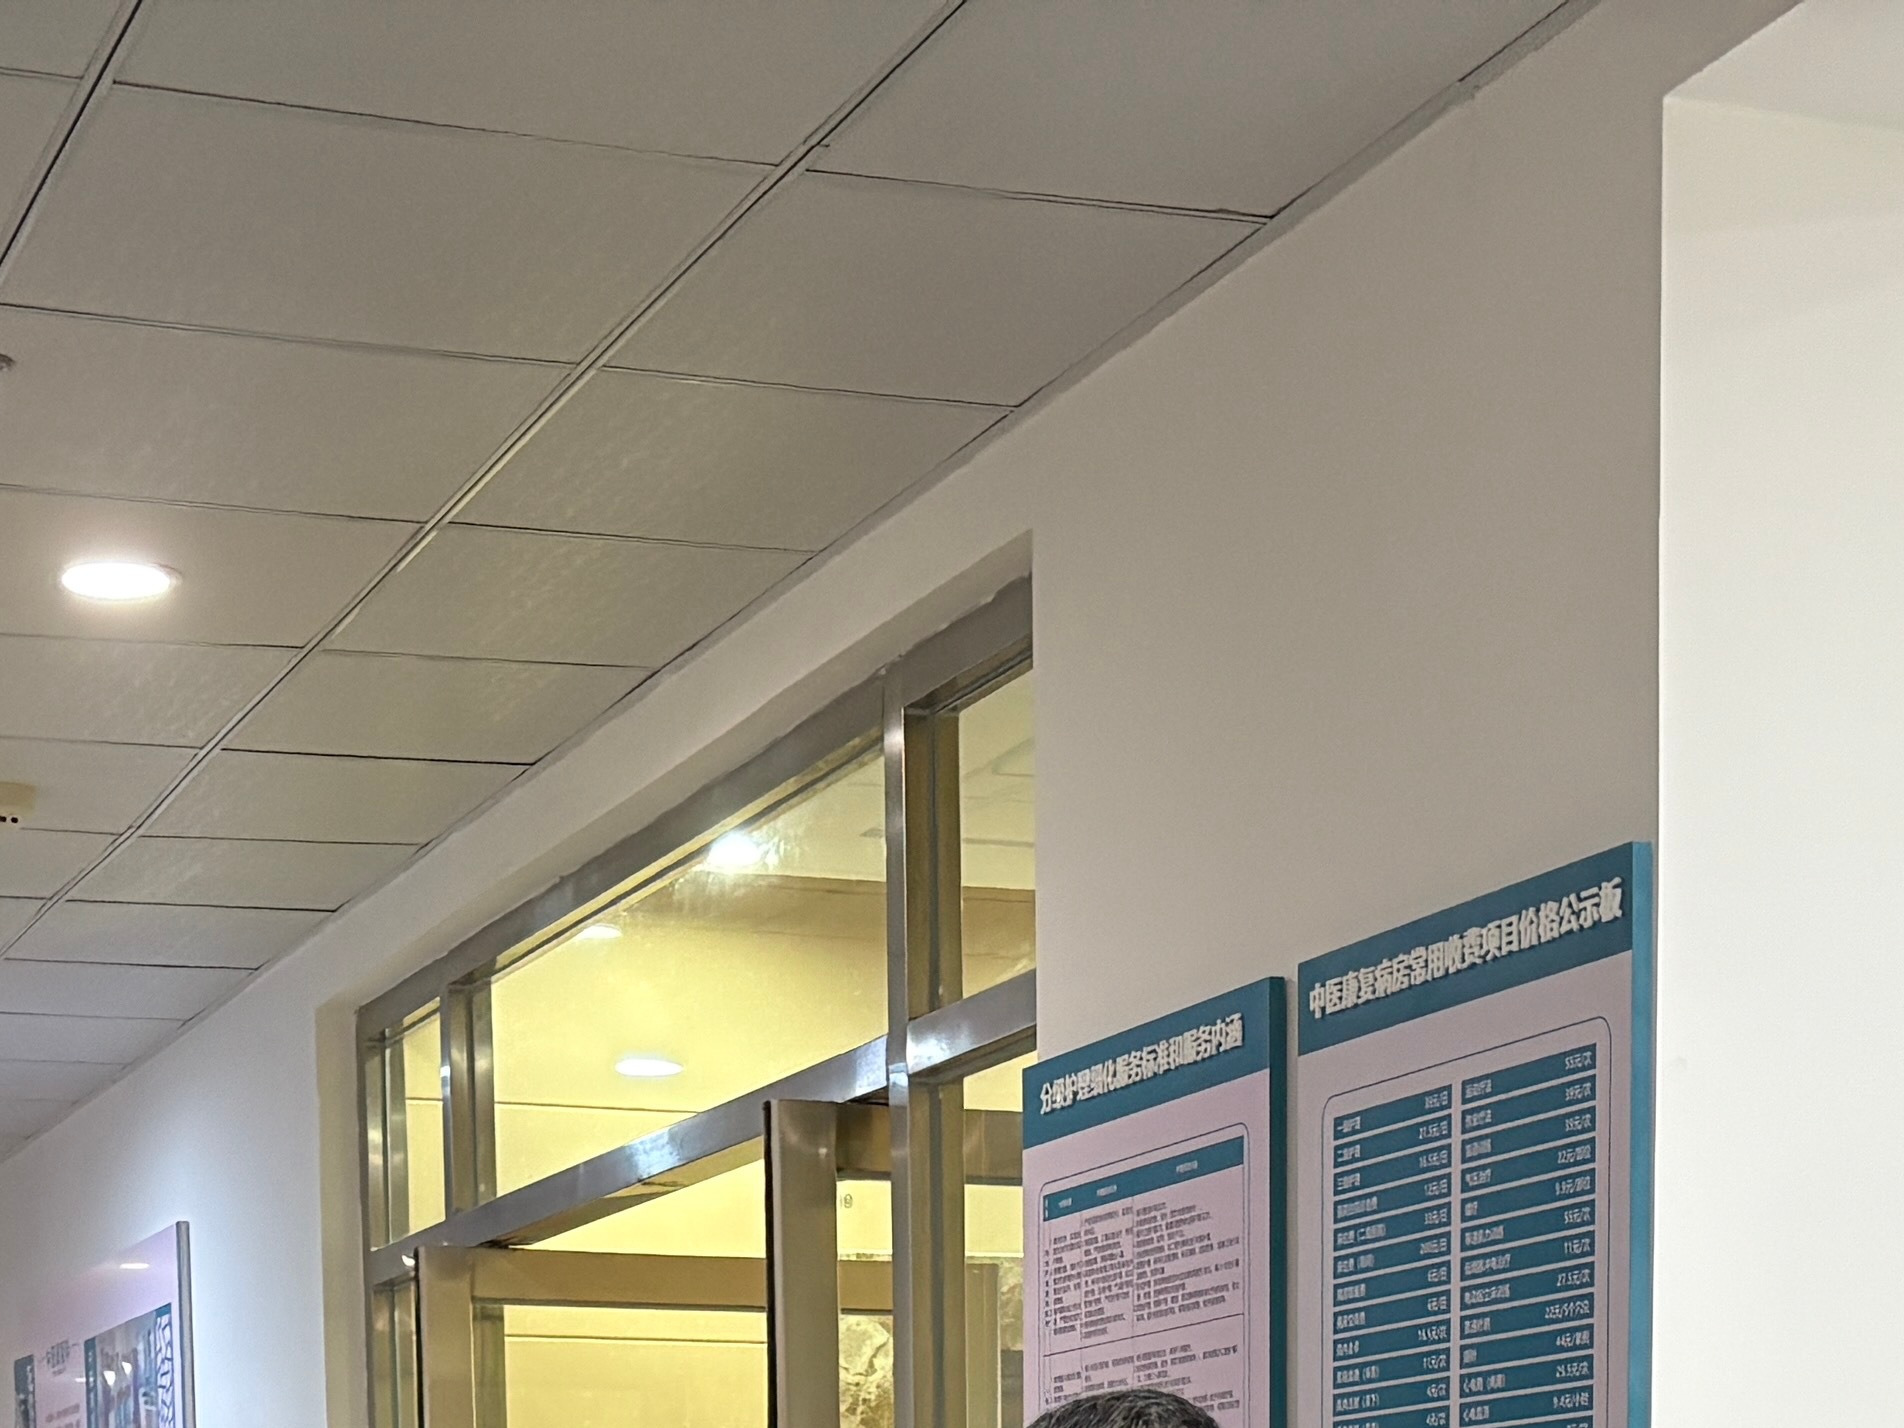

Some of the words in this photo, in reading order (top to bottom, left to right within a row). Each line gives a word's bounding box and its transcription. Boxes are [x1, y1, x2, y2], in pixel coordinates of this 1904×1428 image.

[1309, 877, 1623, 1019] 中医康复病房常用收费项目价格公示板
[1040, 1012, 1244, 1115] 分级护理细化服务标准和服务内涵
